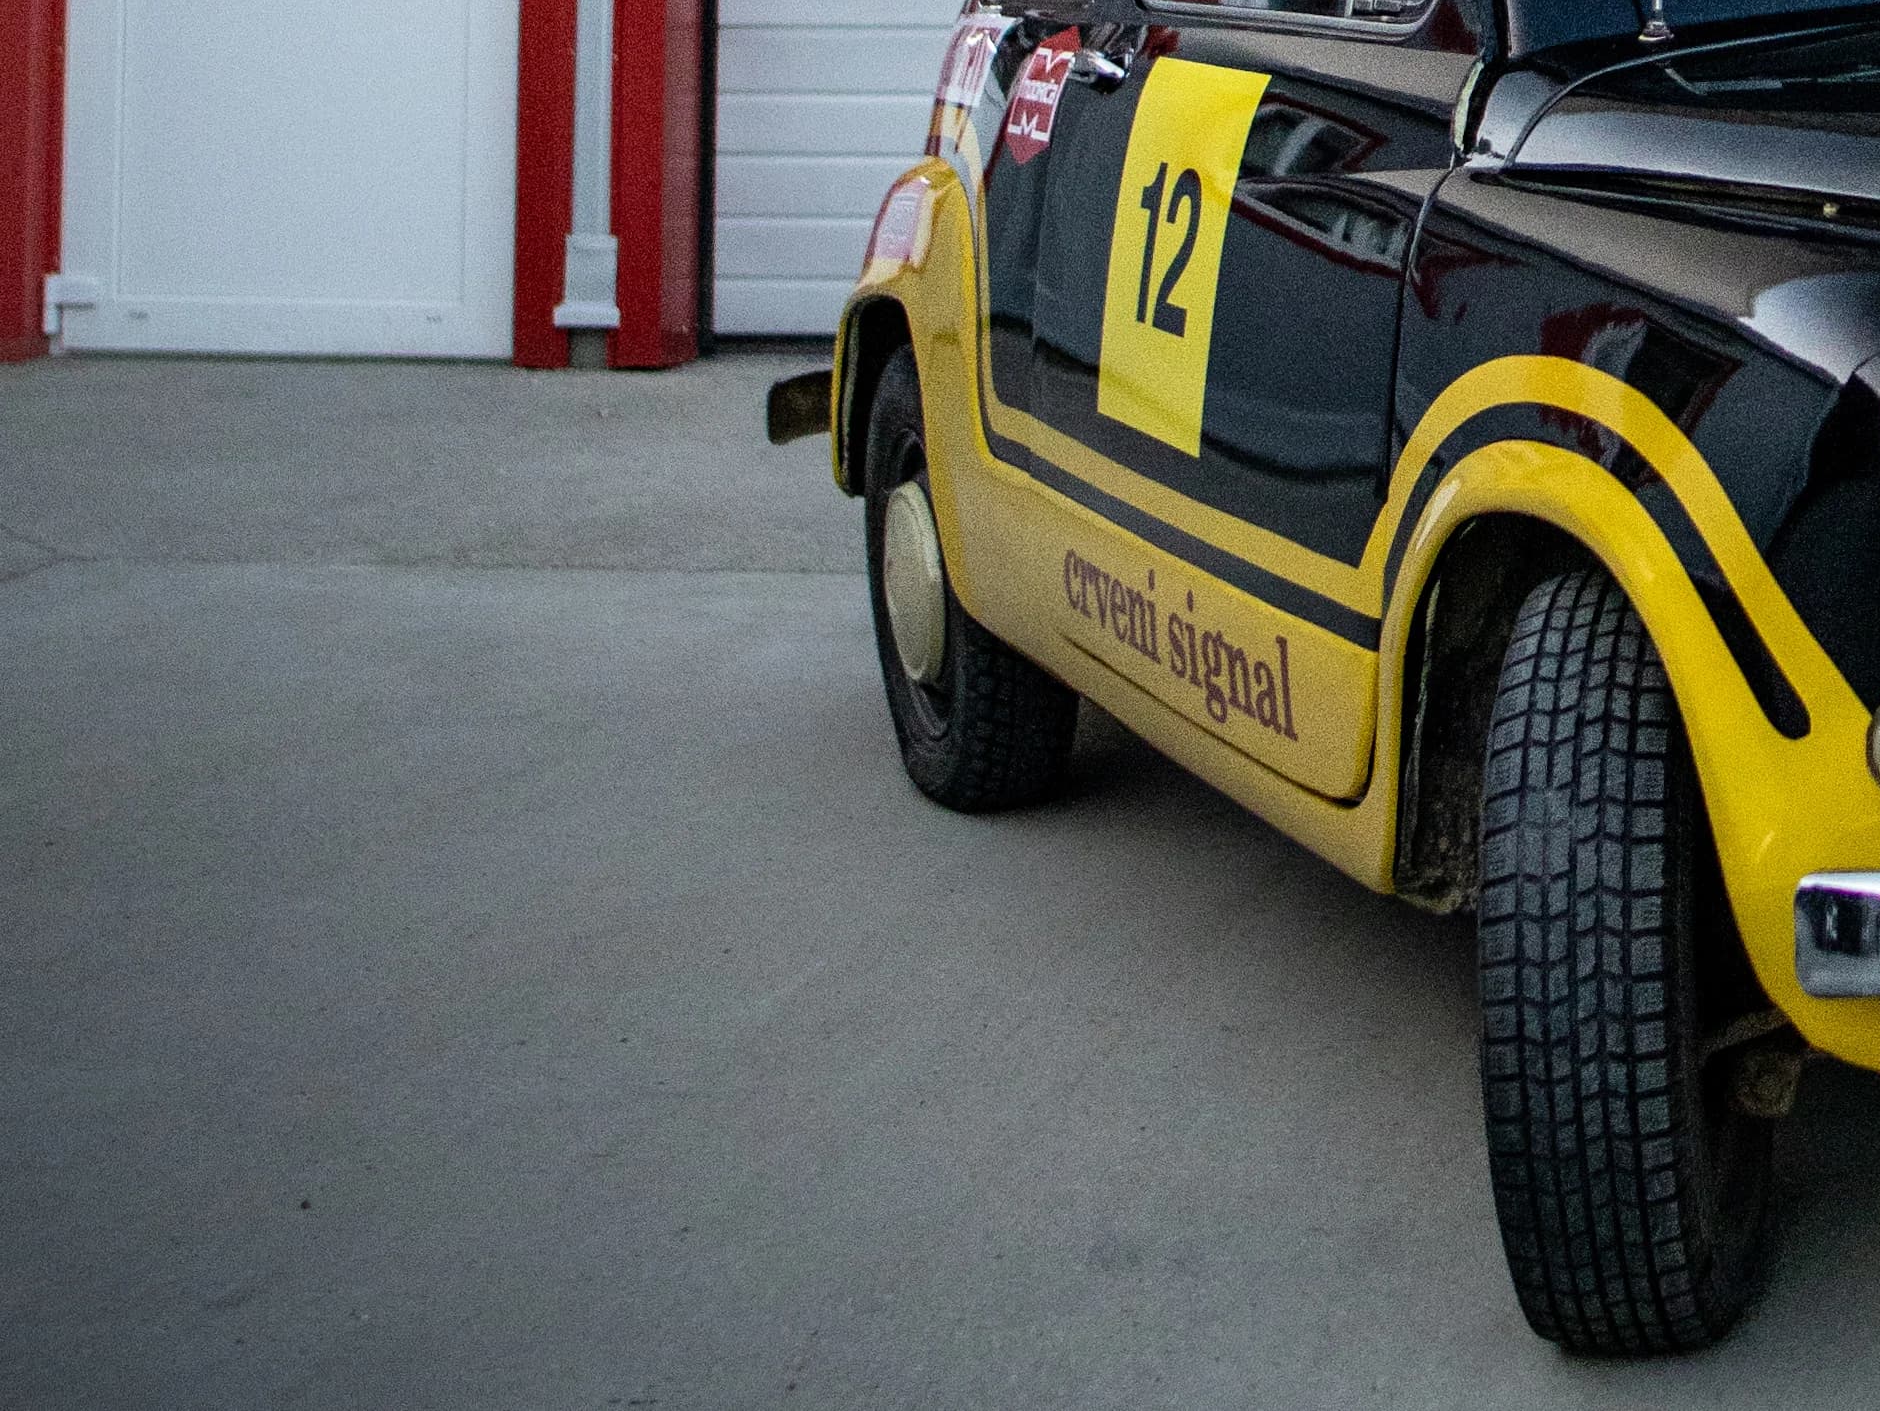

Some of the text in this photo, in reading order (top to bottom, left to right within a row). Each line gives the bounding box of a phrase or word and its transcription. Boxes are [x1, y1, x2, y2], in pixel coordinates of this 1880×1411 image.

[1136, 162, 1202, 338] 12
[1064, 548, 1298, 742] crveni signal
